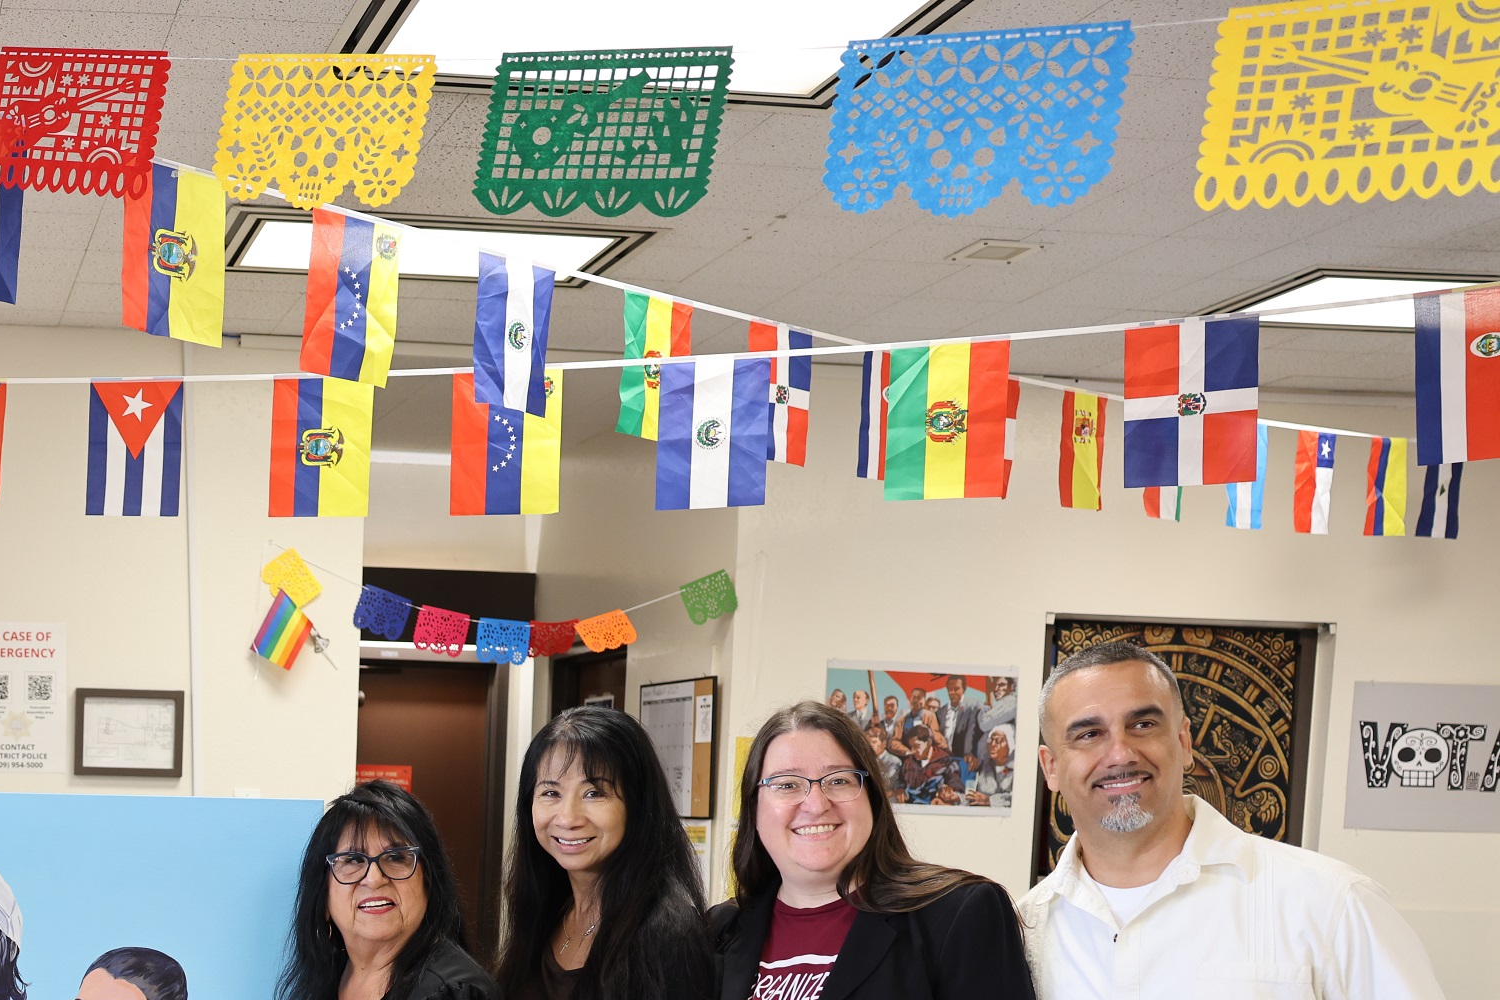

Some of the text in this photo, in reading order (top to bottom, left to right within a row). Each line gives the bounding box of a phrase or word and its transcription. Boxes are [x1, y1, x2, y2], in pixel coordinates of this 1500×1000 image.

[3, 631, 32, 641] CASE
[35, 631, 52, 642] OF
[11, 761, 44, 769] 954-5000
